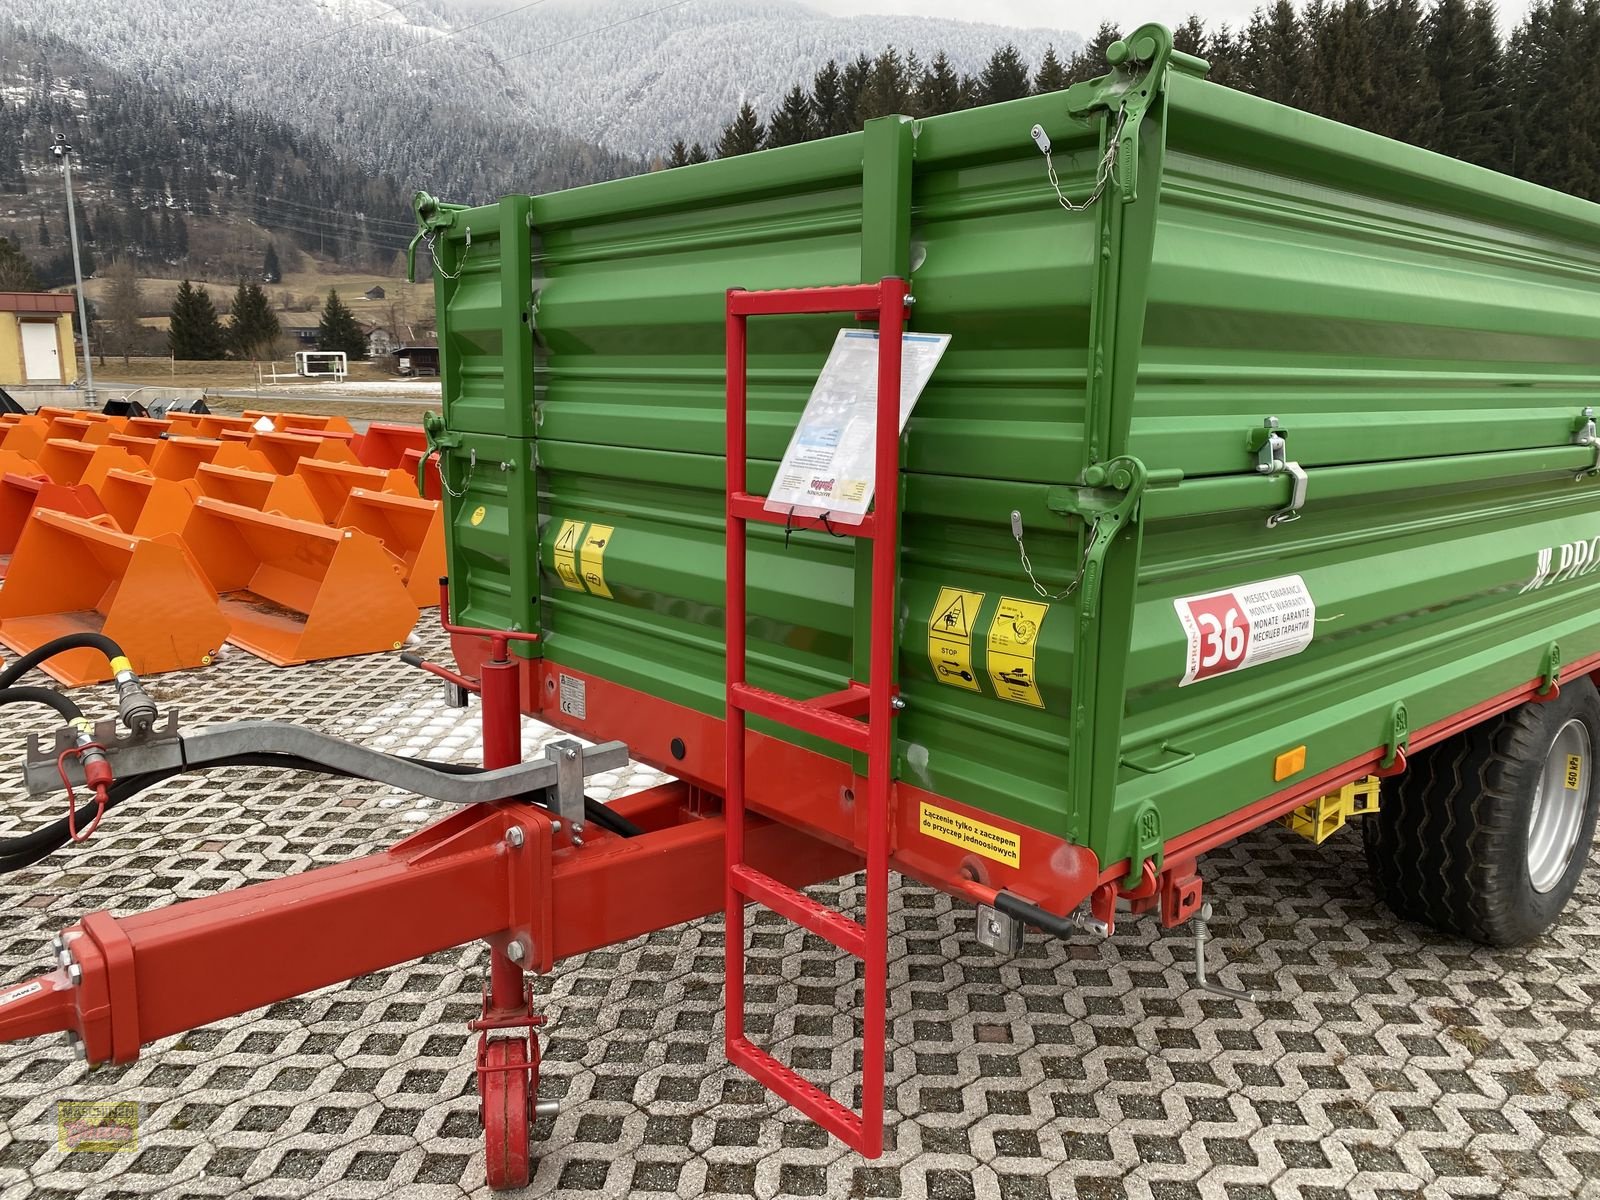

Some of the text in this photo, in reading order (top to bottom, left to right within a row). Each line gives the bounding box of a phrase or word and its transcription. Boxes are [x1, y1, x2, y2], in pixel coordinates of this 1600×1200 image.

[1244, 585, 1302, 604] MIESIĘCY GWARANCJI
[1249, 596, 1307, 616] MONTHS WARRANTY
[1253, 608, 1310, 629] MONATE GARANTIE
[1198, 608, 1245, 667] 36
[1253, 621, 1309, 642] МЕСЯЦЕВ ГАРАНТИИ
[941, 647, 958, 656] STOP
[1567, 757, 1579, 787] 450 kPa
[924, 808, 954, 825] Łączenie
[955, 820, 973, 832] tylko
[980, 829, 1016, 847] zaczepem
[923, 819, 1017, 859] do przyczep jednoosiowych
